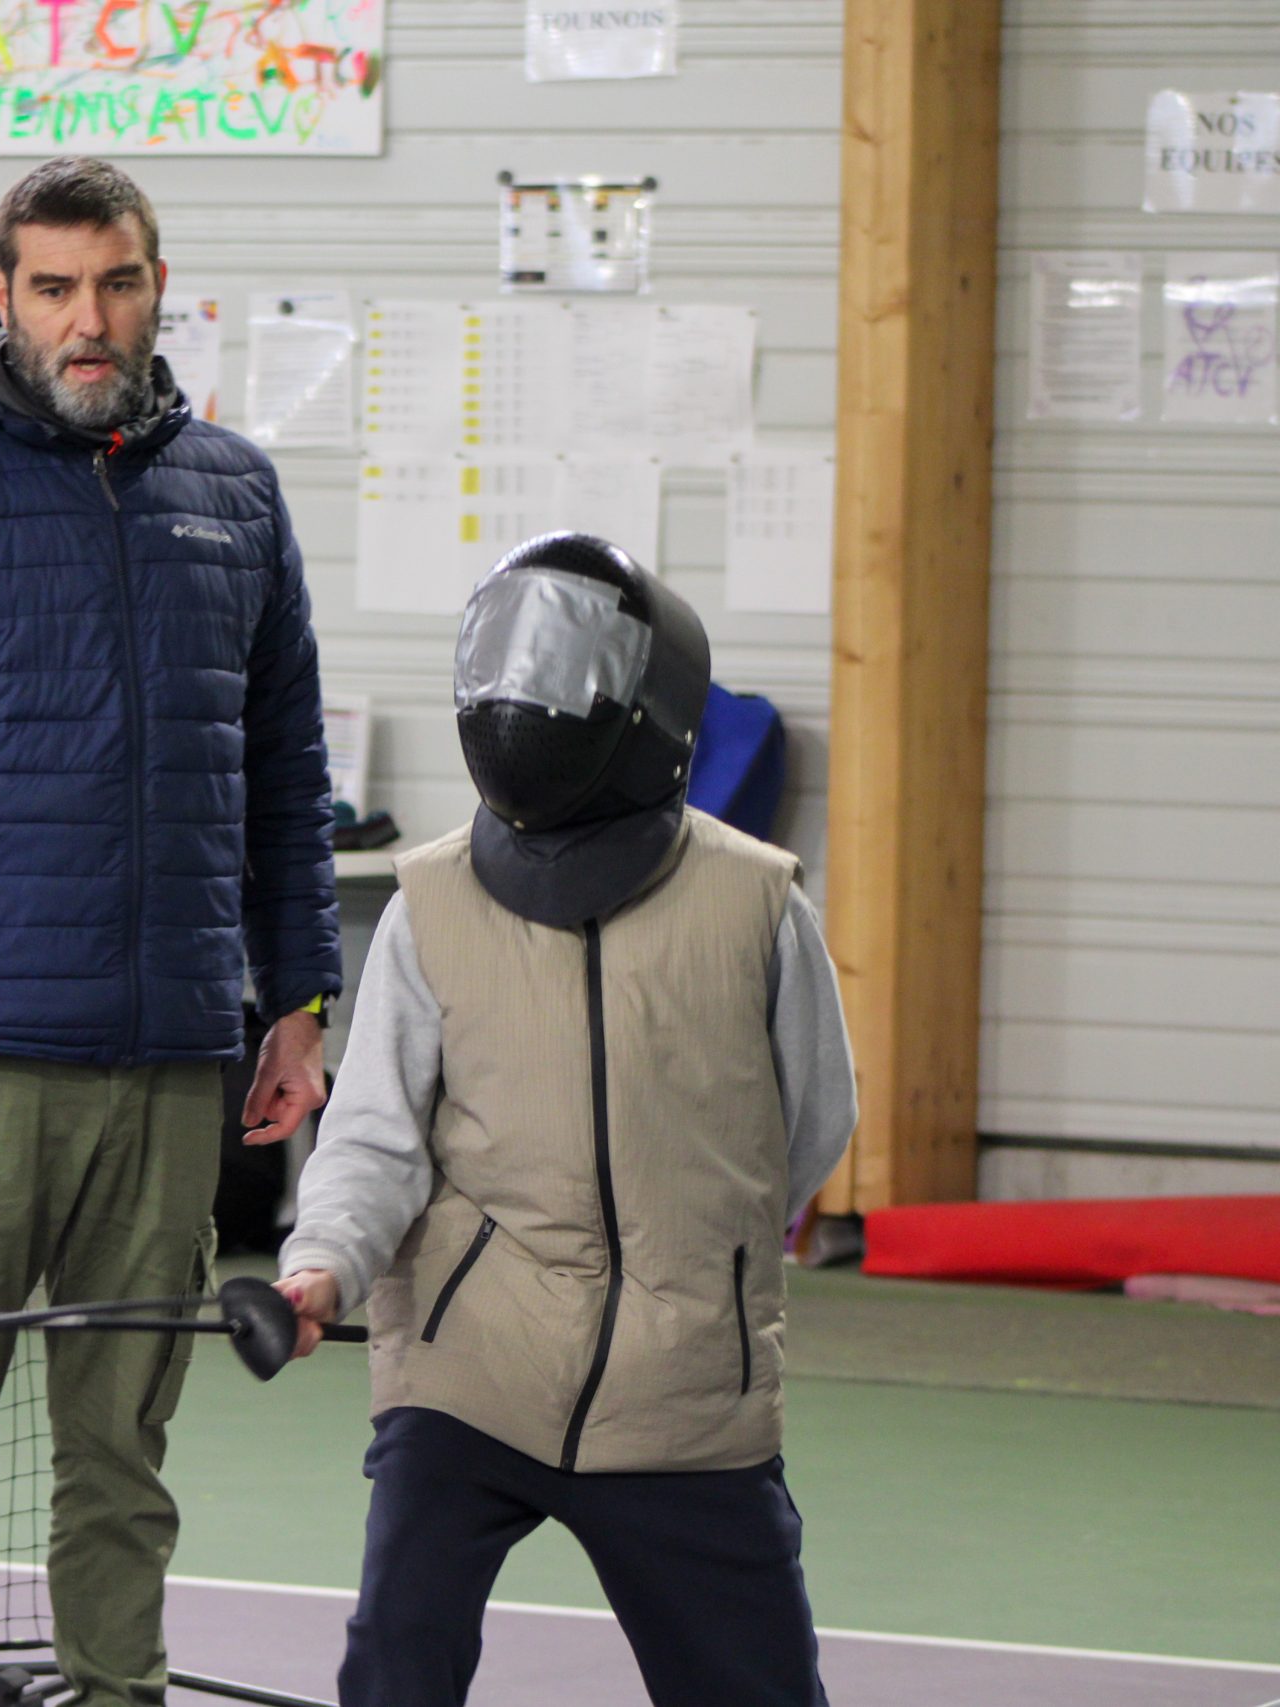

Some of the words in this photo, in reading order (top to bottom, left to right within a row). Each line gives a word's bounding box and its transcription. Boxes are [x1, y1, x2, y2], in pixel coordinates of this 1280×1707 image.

[542, 9, 665, 31] TOURNOIS
[147, 84, 294, 142] ATCV
[1198, 111, 1255, 137] NOS
[1167, 352, 1256, 399] ATCV
